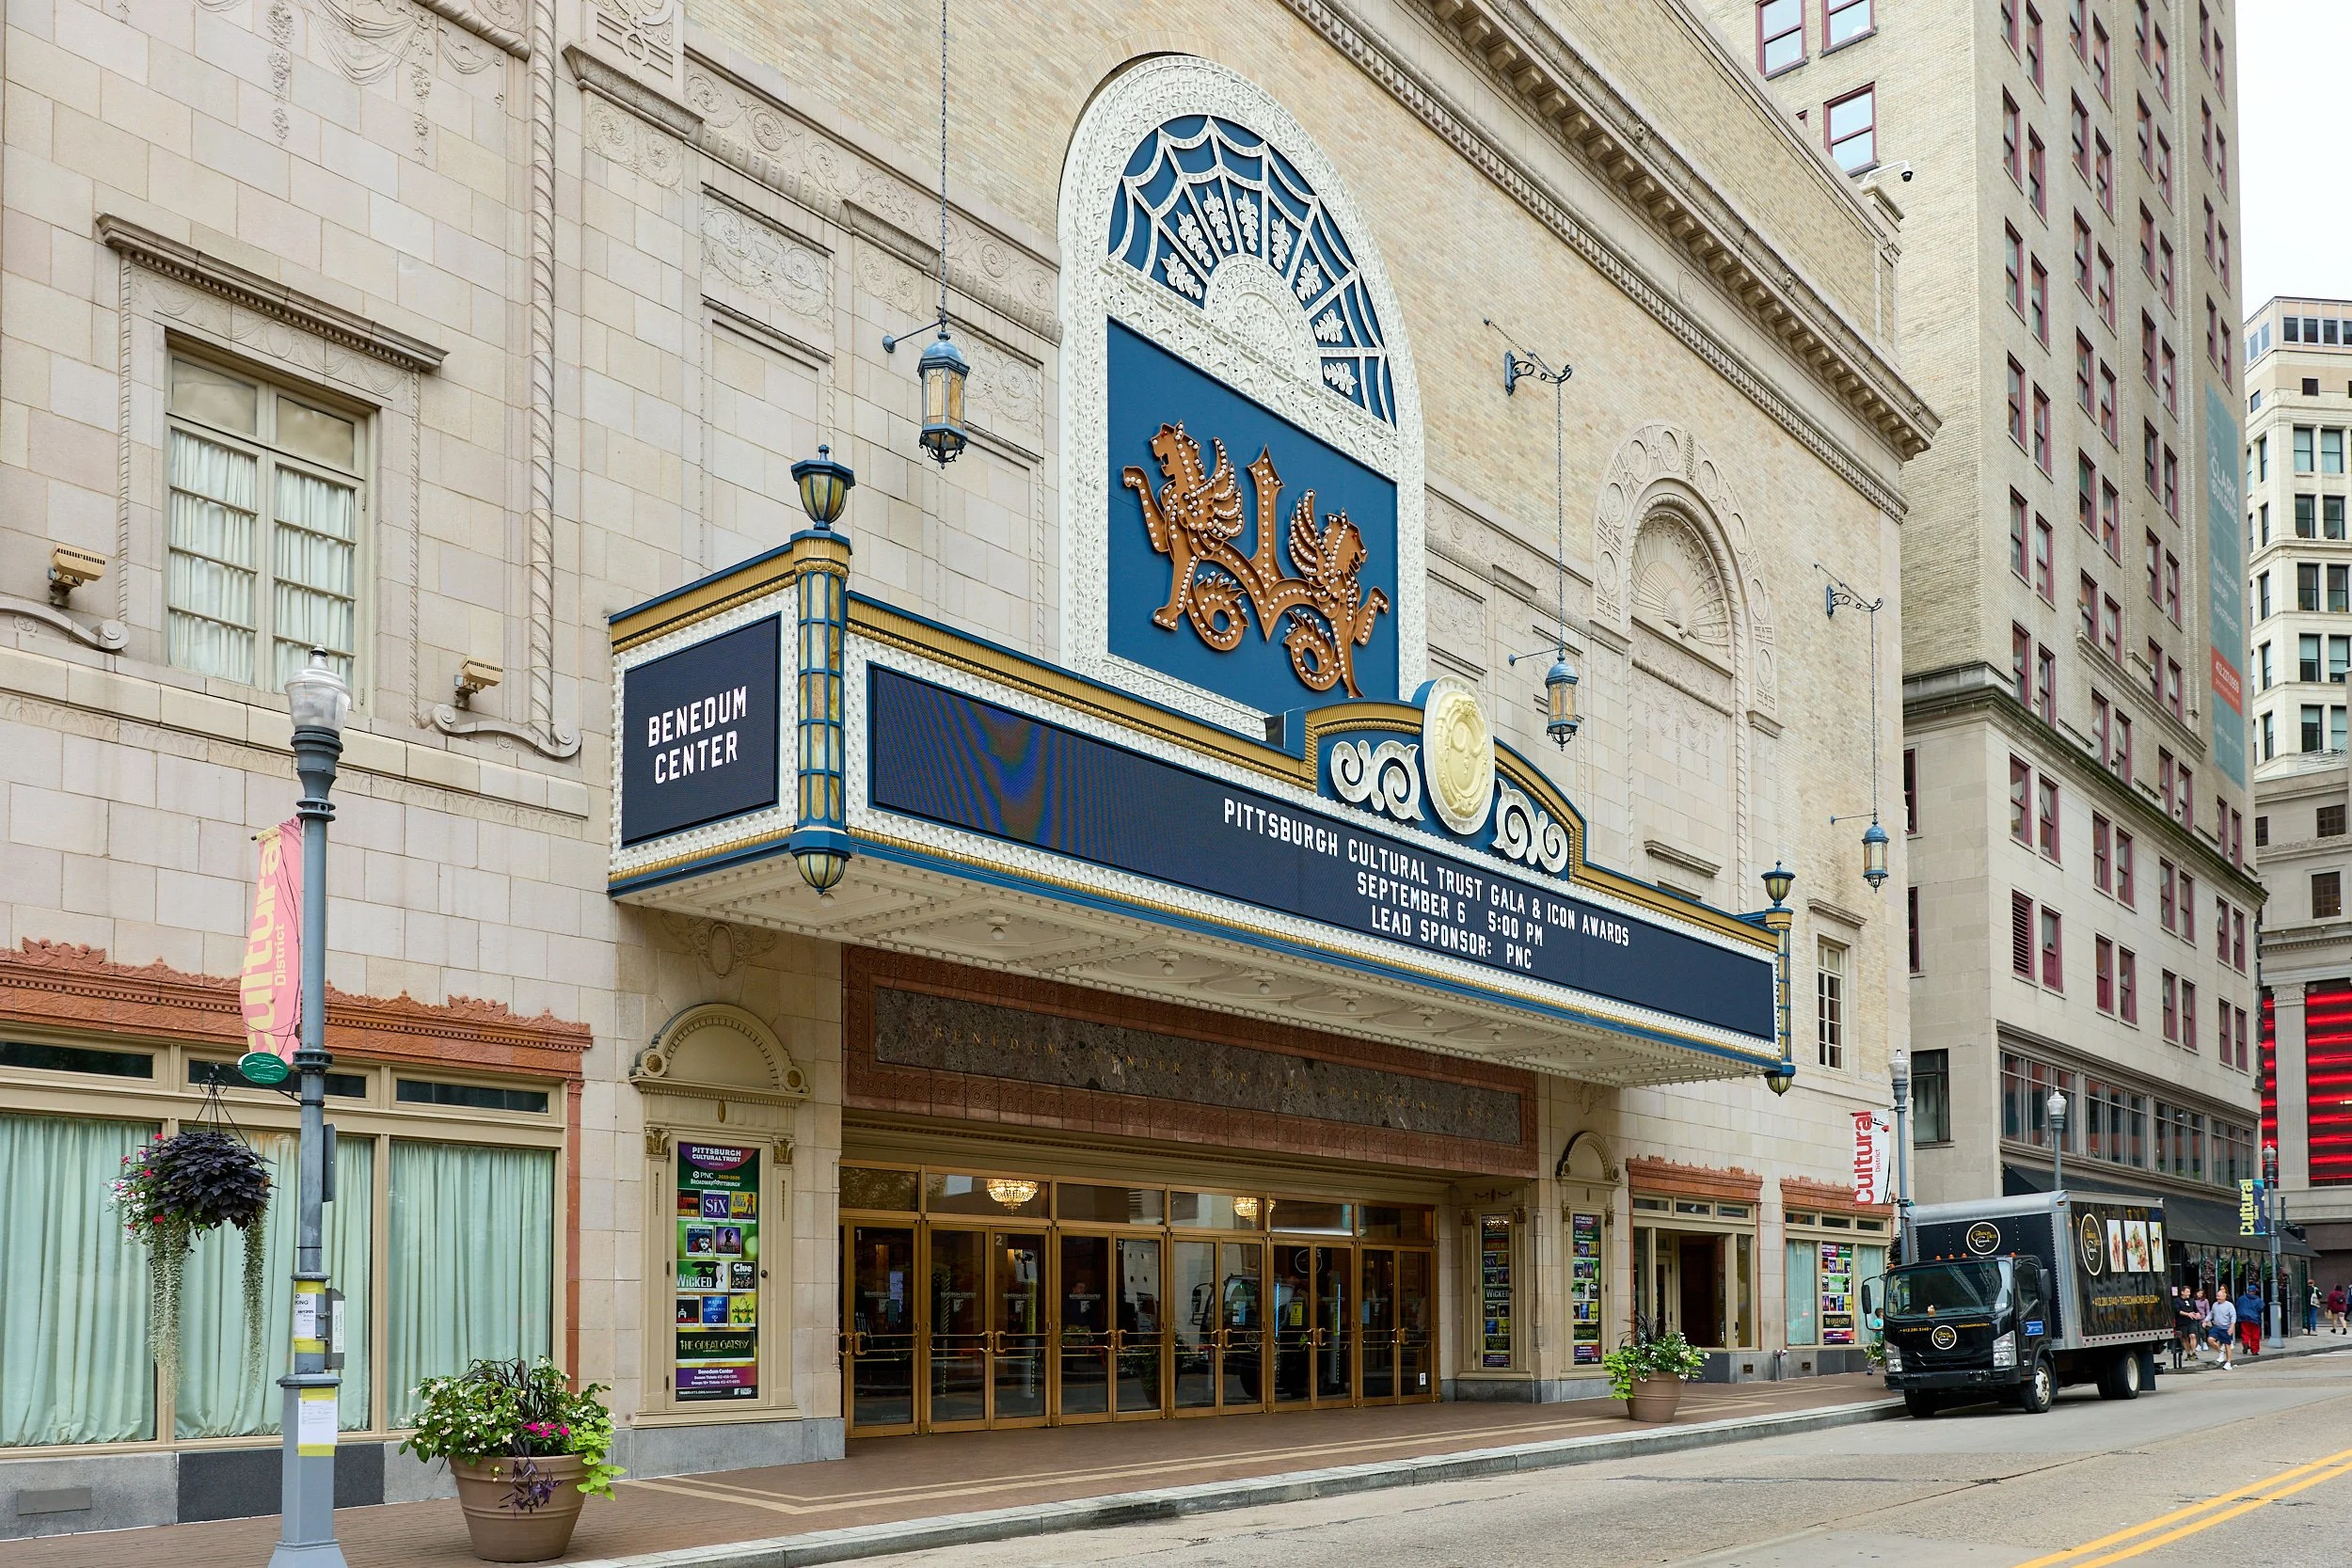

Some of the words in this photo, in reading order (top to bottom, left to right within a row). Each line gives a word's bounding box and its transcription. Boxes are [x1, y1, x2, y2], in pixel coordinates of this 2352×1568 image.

[647, 686, 747, 748] BENEDUM
[655, 730, 739, 784] CENTER
[1223, 798, 1339, 857] PITTSBURGH
[1347, 838, 1430, 885] CULTURAL
[1436, 865, 1483, 902] TRUST
[1490, 884, 1526, 915] GALA
[1532, 897, 1541, 919] &
[1547, 902, 1576, 930] ICON
[1581, 914, 1629, 946] AWARDS
[1357, 871, 1449, 919] SEPTEMBER
[1457, 901, 1467, 924] 6
[1487, 910, 1519, 940] 5:00
[1526, 921, 1543, 947] PM
[1372, 904, 1411, 937] LEAD
[1420, 918, 1492, 958] SPONSOR:
[1506, 942, 1533, 969] PNC
[274, 924, 287, 987] District
[691, 1147, 741, 1157] PITTSBURGH
[691, 1154, 723, 1163] CULTURAL
[1851, 1111, 1875, 1206] Cultural
[700, 1171, 714, 1180] PNC
[2239, 1179, 2255, 1235] Cultural
[856, 1229, 862, 1241] 1
[995, 1235, 1003, 1245] 2
[1118, 1241, 1123, 1250] 3
[734, 1263, 753, 1272] Clue
[679, 1339, 694, 1351] THE
[694, 1339, 718, 1350] GREAT
[720, 1339, 749, 1350] GATSBY
